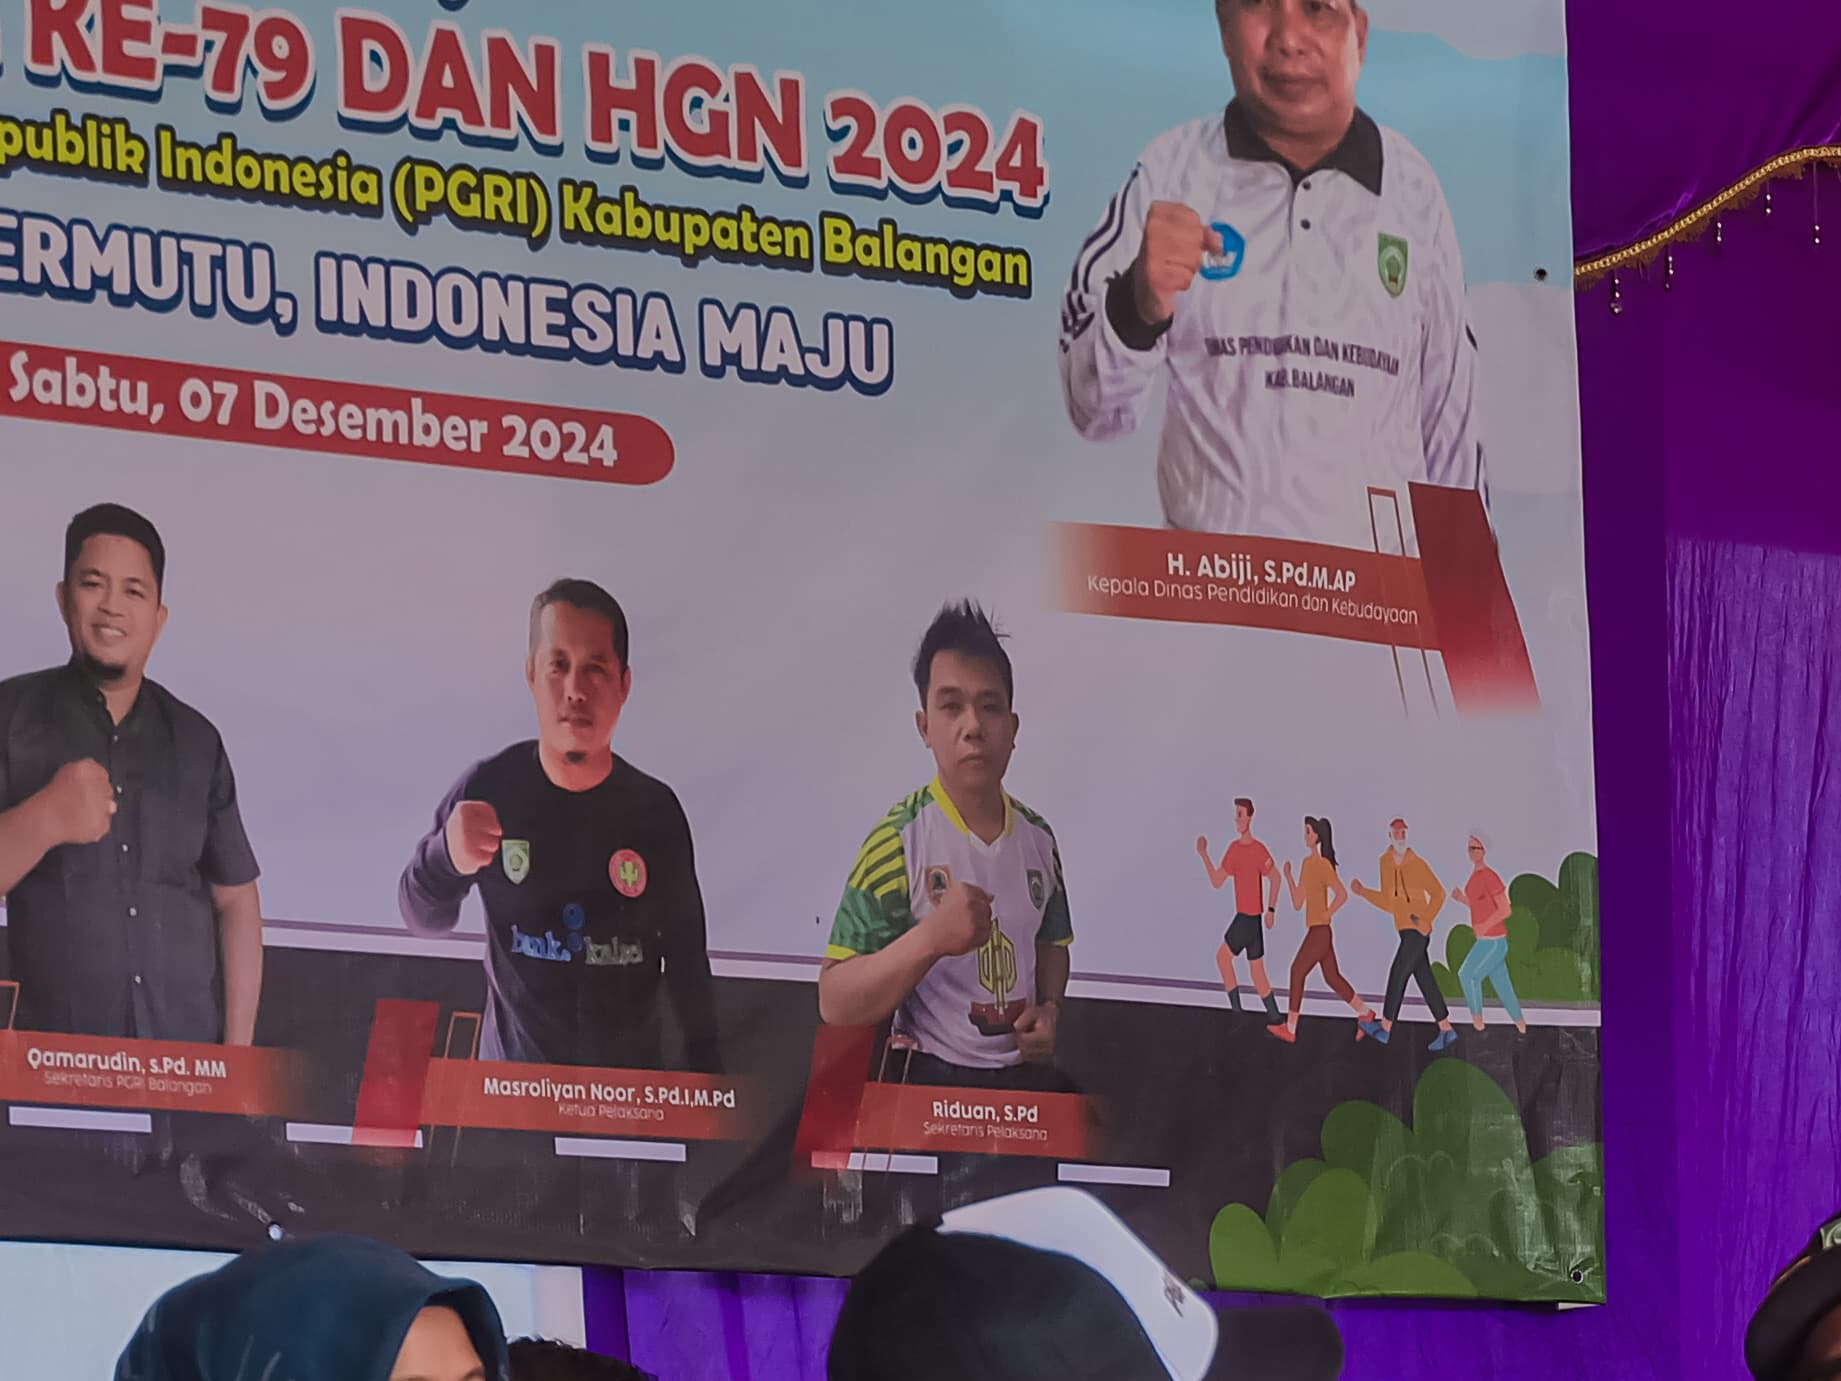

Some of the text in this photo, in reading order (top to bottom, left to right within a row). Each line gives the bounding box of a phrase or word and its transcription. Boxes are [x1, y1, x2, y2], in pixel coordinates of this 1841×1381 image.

[27, 0, 1047, 203] KE-79 DAN HGN 2024
[157, 130, 379, 206] Indonesia
[394, 161, 549, 238] (PGRI)
[562, 183, 811, 261] Kabupaten
[823, 216, 1028, 287] Balangan
[319, 256, 682, 364] INDONESIA
[704, 303, 890, 384] MAJU
[8, 350, 618, 468] Sabtu, 07 Desember 2024
[1166, 552, 1356, 593] H. Abiji, S.Pd.M.AP
[1087, 575, 1419, 626] Kepala Dinas Pendidikan dan Kebudayaan
[27, 1047, 146, 1074] Qamarudin,
[195, 1059, 227, 1079] MM
[149, 1078, 213, 1097] Balangan
[483, 1076, 586, 1103] Masroliyan
[590, 1083, 641, 1106] Noor,
[558, 1102, 665, 1121] Ketua Pelaksana
[932, 1100, 1039, 1124] Riduan, S.Pd
[923, 1121, 1048, 1141] Sekretaris Pelaksana
